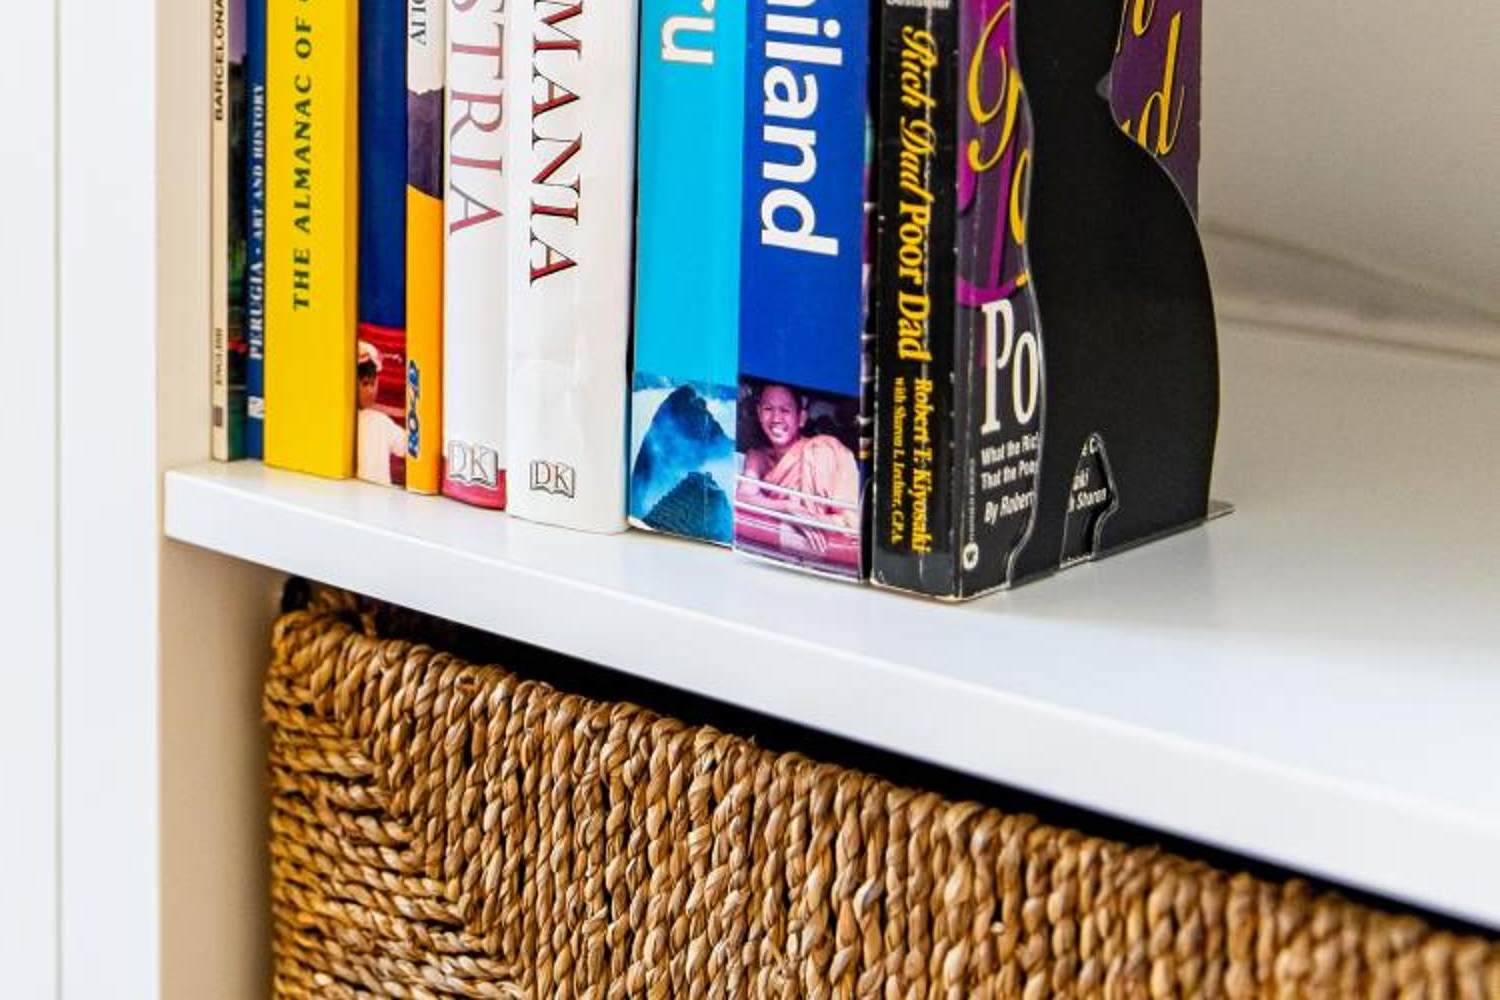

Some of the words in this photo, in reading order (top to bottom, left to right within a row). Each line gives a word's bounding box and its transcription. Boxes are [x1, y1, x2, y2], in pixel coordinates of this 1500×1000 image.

[294, 16, 313, 59] OF
[901, 25, 938, 107] Rich
[252, 85, 264, 159] HISTORY
[253, 165, 264, 198] AND
[294, 75, 312, 234] ALMANAC
[900, 116, 936, 202] Dad
[253, 208, 264, 239] ART
[899, 200, 930, 285] Poor
[249, 261, 264, 360] PERUGIA
[293, 248, 311, 311] THE
[898, 290, 933, 362] Dad
[913, 378, 935, 441] Robert
[449, 442, 491, 479] DK
[533, 459, 573, 491] DK
[981, 444, 1005, 467] What
[1006, 439, 1021, 457] the
[981, 469, 1001, 490] That
[1003, 465, 1017, 484] the
[908, 468, 933, 552] Kiyosaki
[984, 501, 999, 525] By
